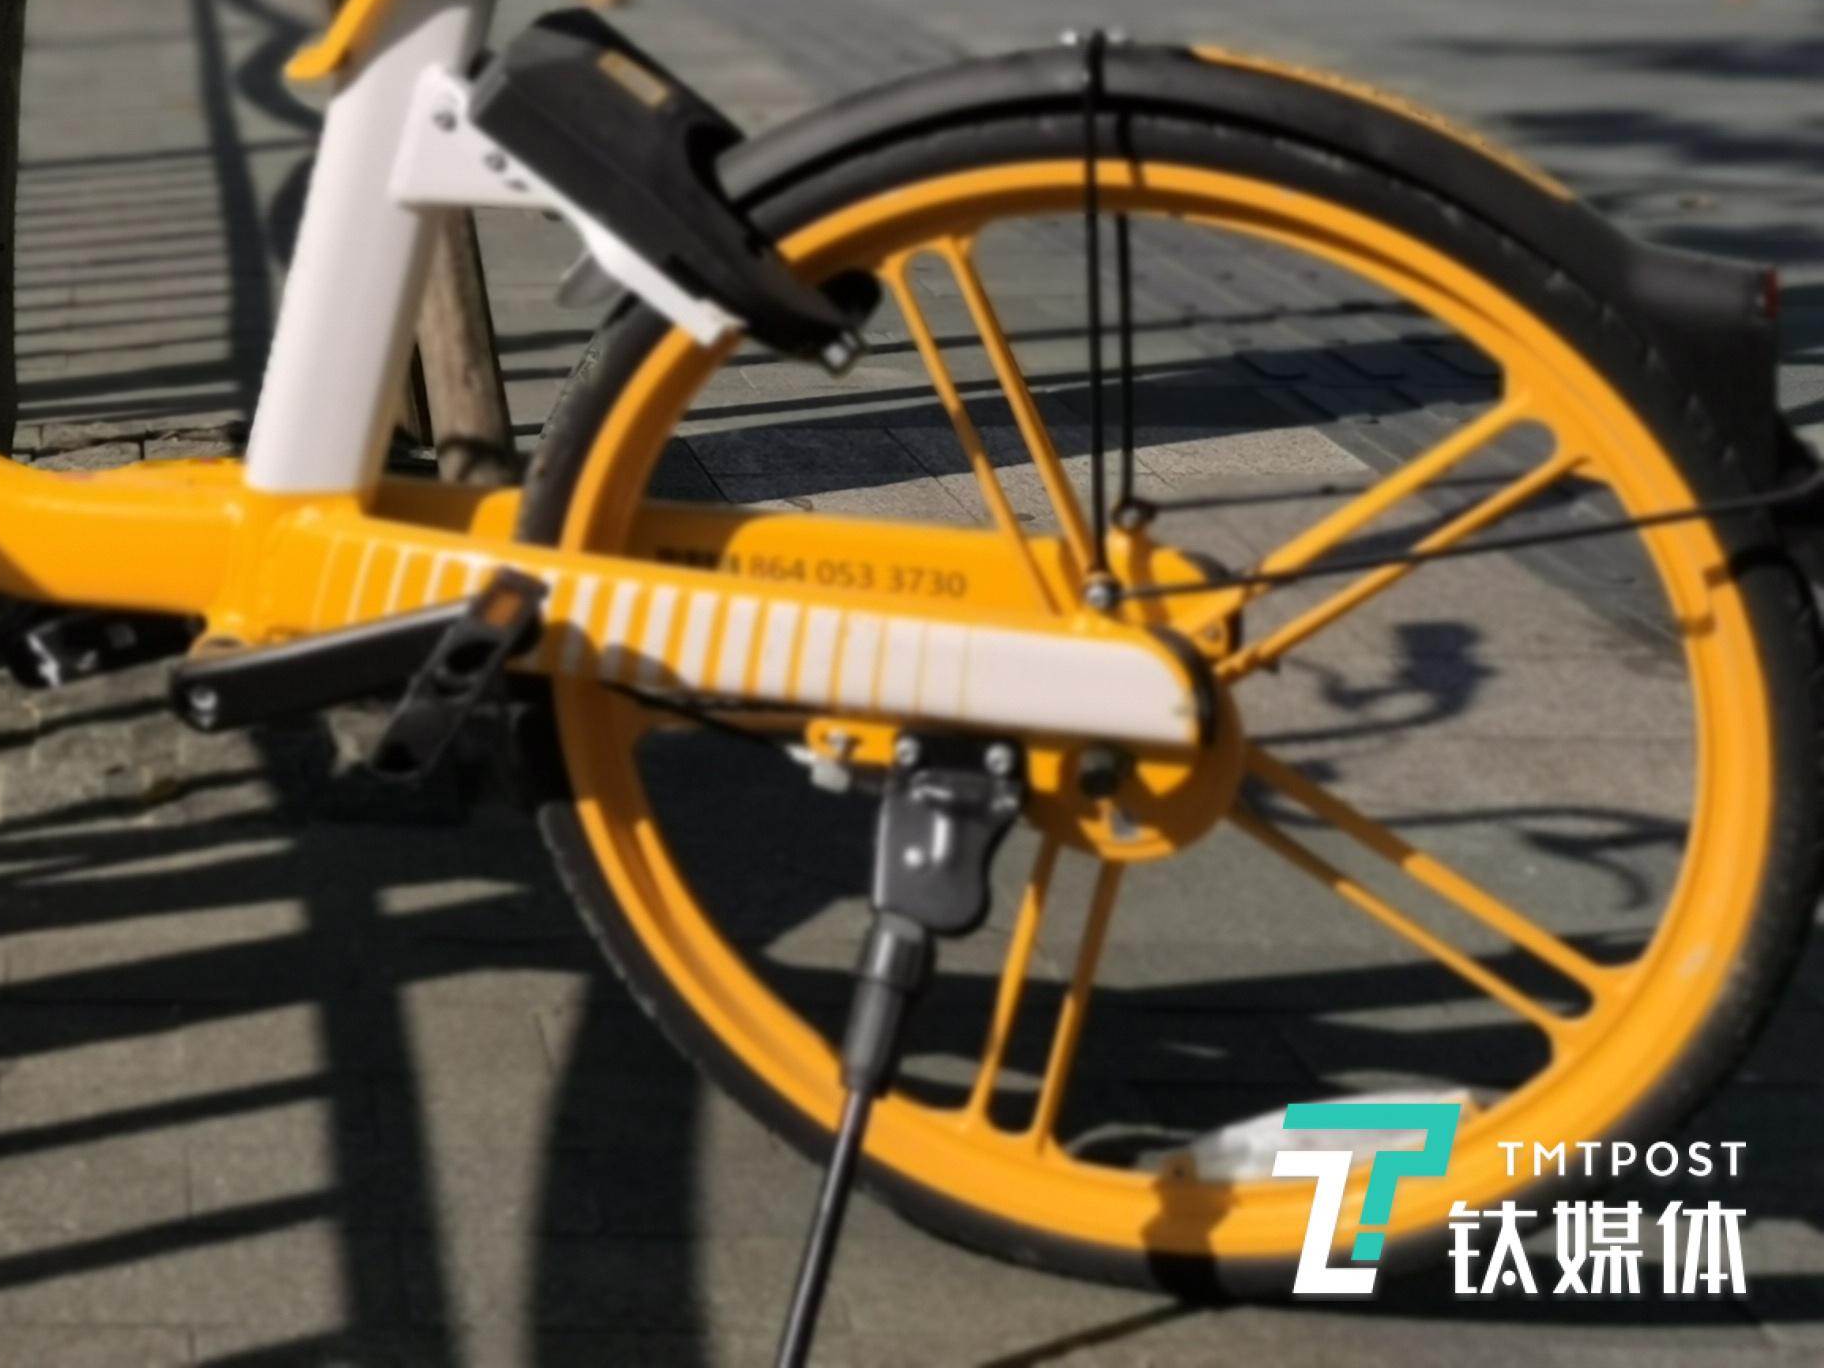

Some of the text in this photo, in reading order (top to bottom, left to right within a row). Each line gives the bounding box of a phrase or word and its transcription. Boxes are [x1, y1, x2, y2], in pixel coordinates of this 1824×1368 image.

[749, 556, 806, 583] 864
[817, 561, 874, 589] 053
[887, 568, 967, 598] 3730
